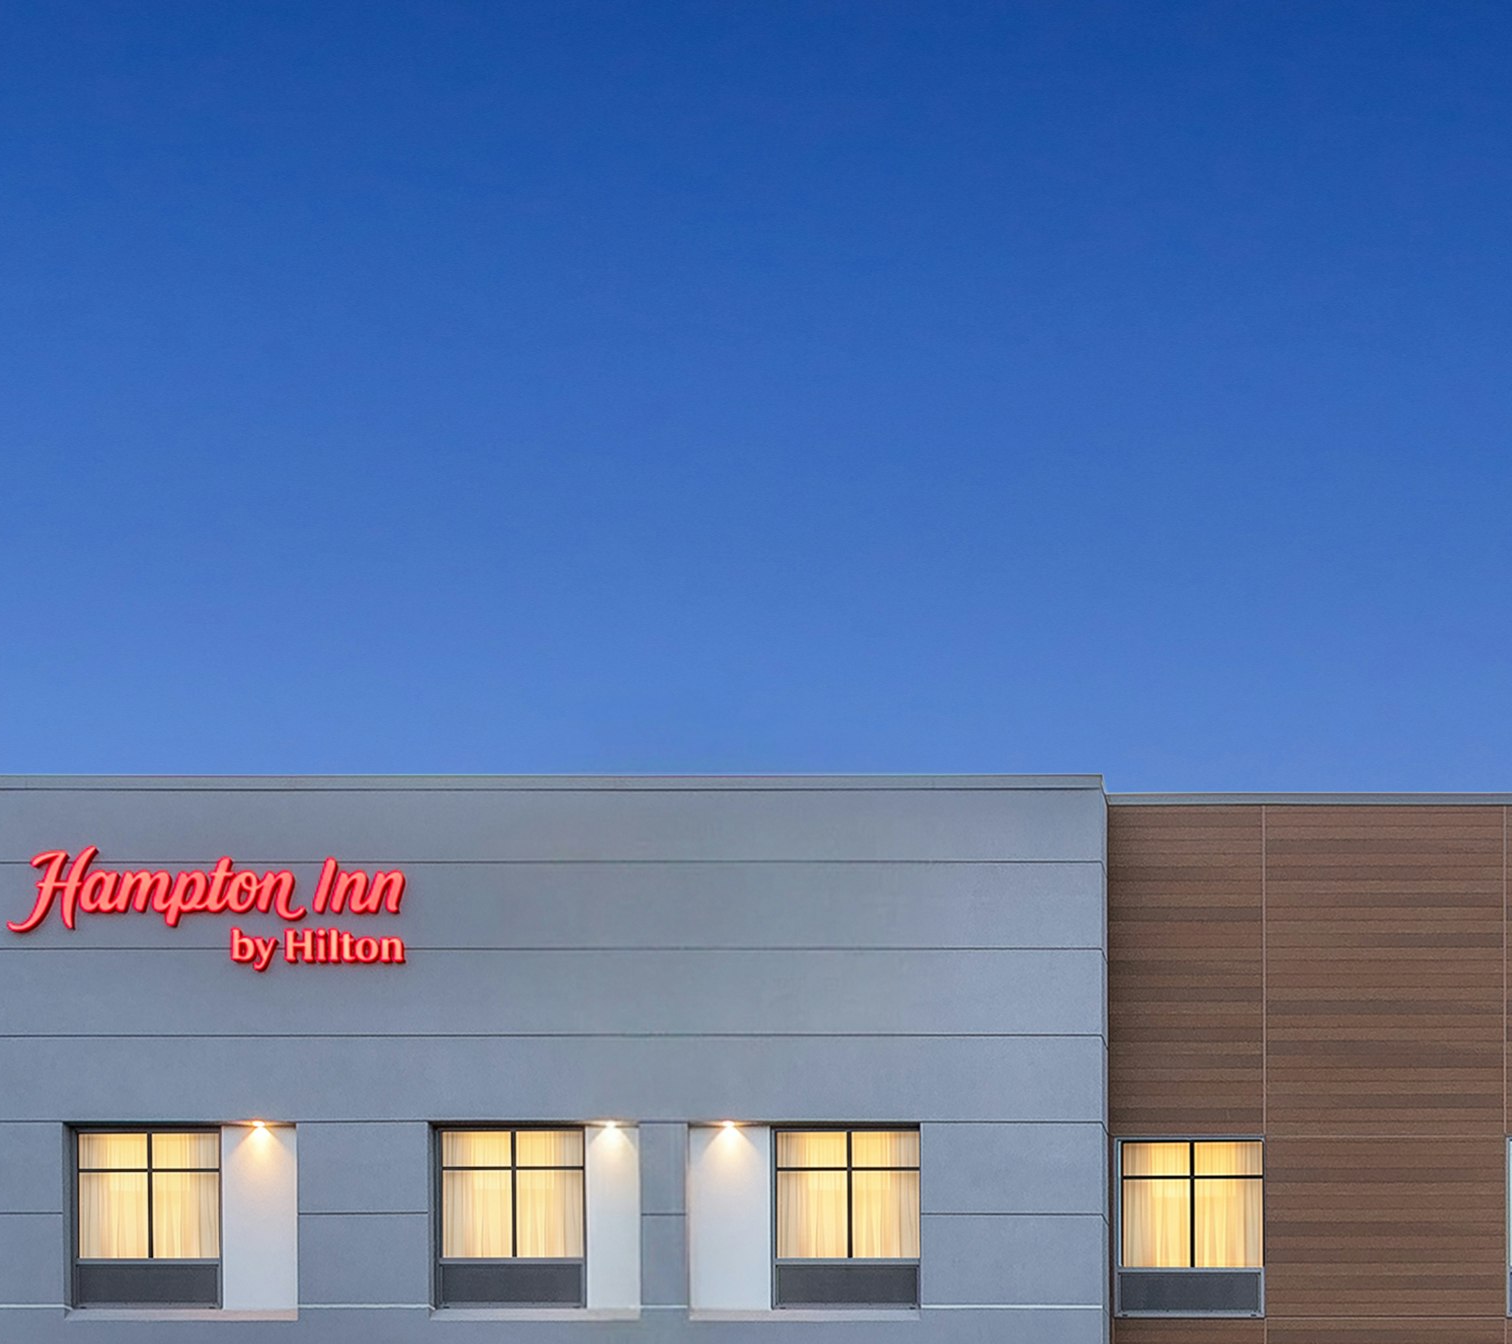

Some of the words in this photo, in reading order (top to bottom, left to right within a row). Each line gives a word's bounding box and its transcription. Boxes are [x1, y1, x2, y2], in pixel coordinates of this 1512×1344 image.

[7, 846, 307, 933] Hampton
[312, 857, 405, 914] Inn
[230, 927, 278, 972] by
[283, 928, 405, 964] Hilton
